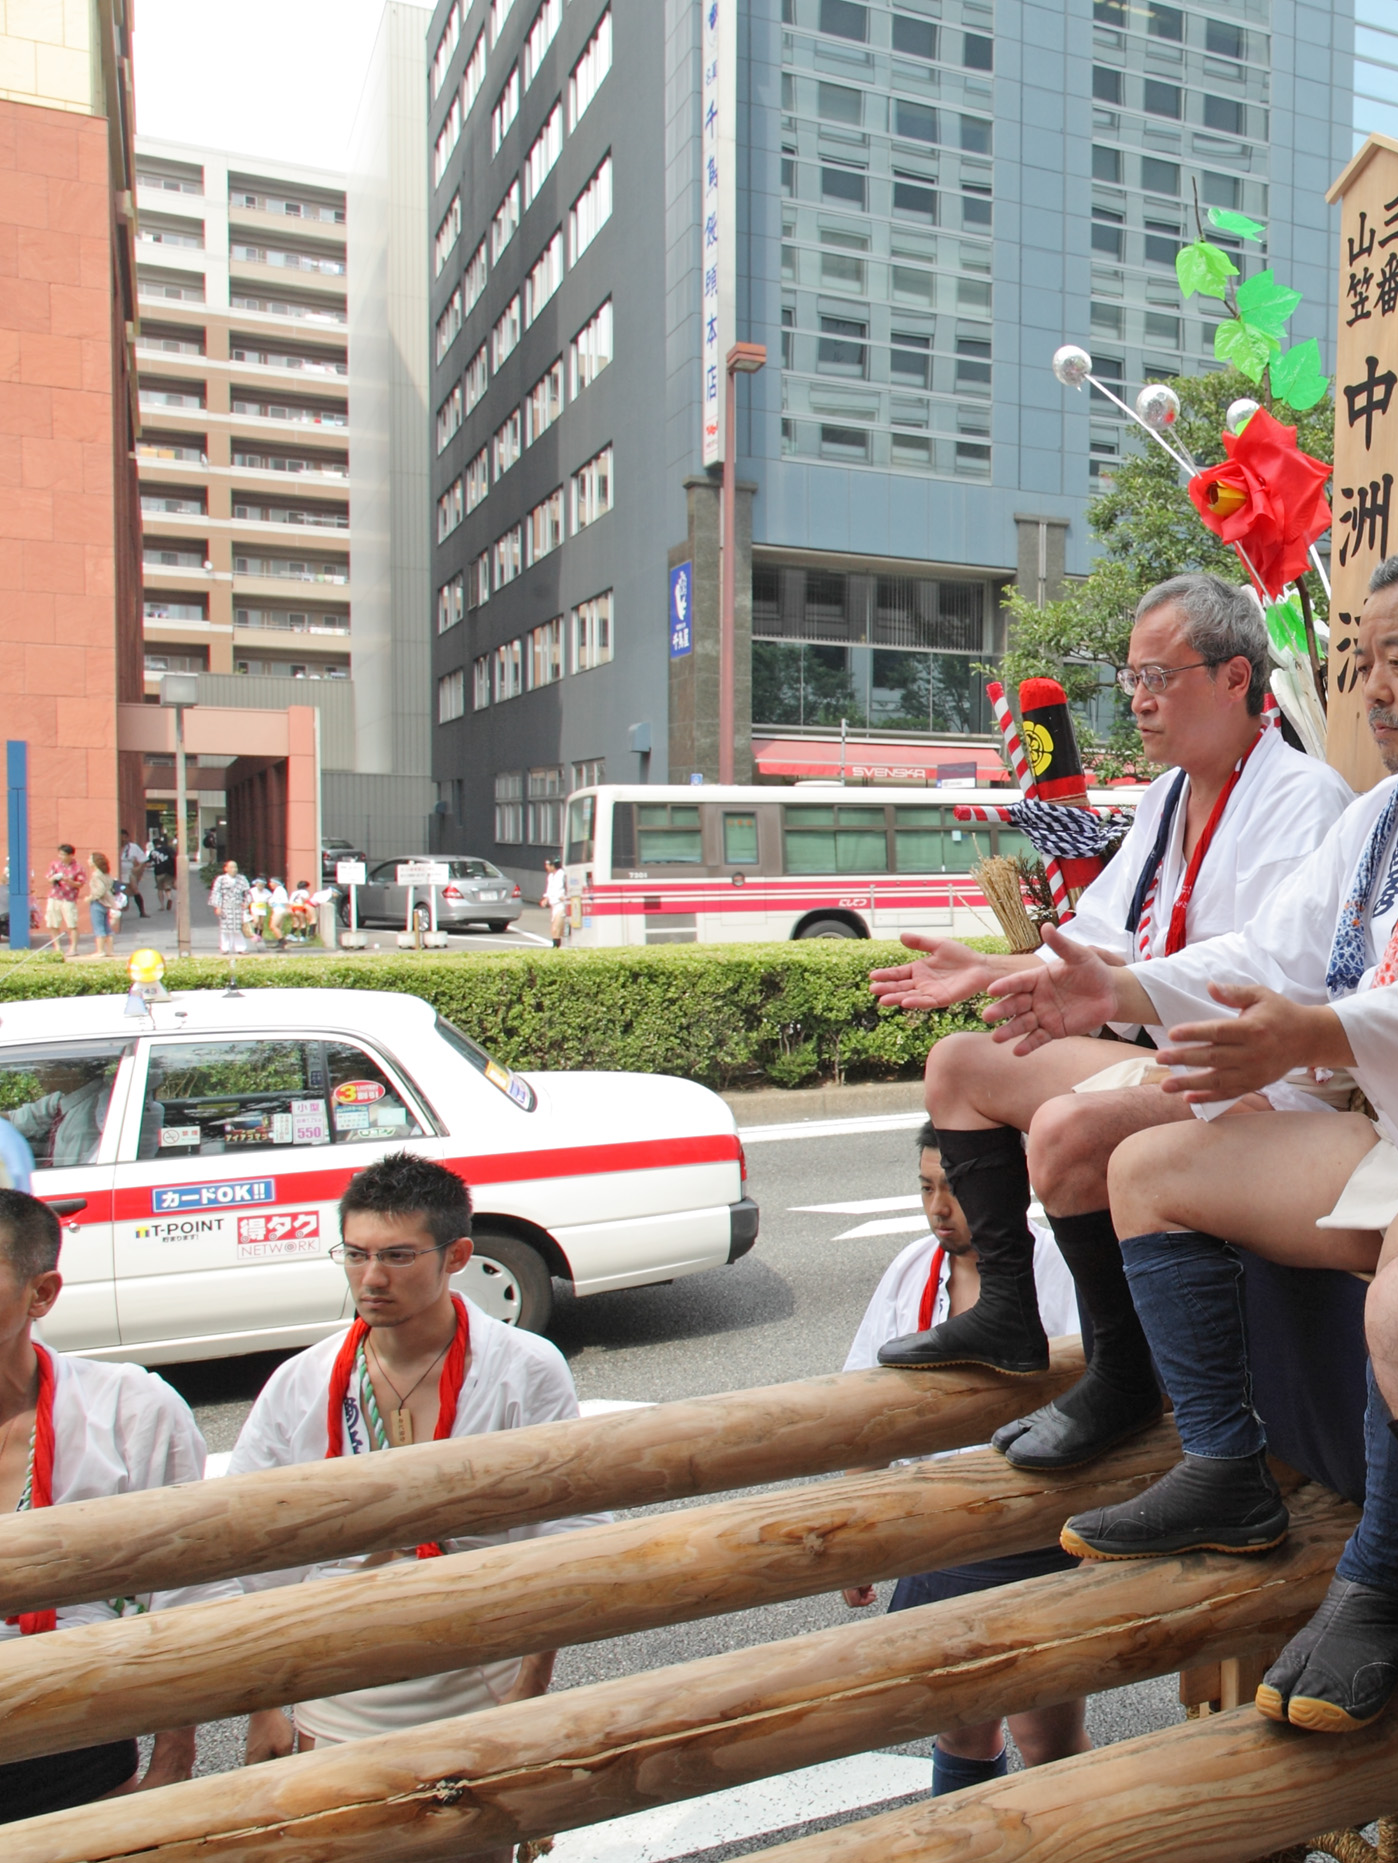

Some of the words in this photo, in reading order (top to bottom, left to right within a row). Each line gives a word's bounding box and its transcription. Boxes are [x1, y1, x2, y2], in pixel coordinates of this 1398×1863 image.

[1345, 211, 1377, 328] 山笠
[852, 766, 926, 778] SVENSKA
[297, 1126, 322, 1139] 550
[162, 1183, 266, 1208] カードOK!!
[151, 1218, 225, 1237] T-POINT
[240, 1214, 318, 1243] 得タク
